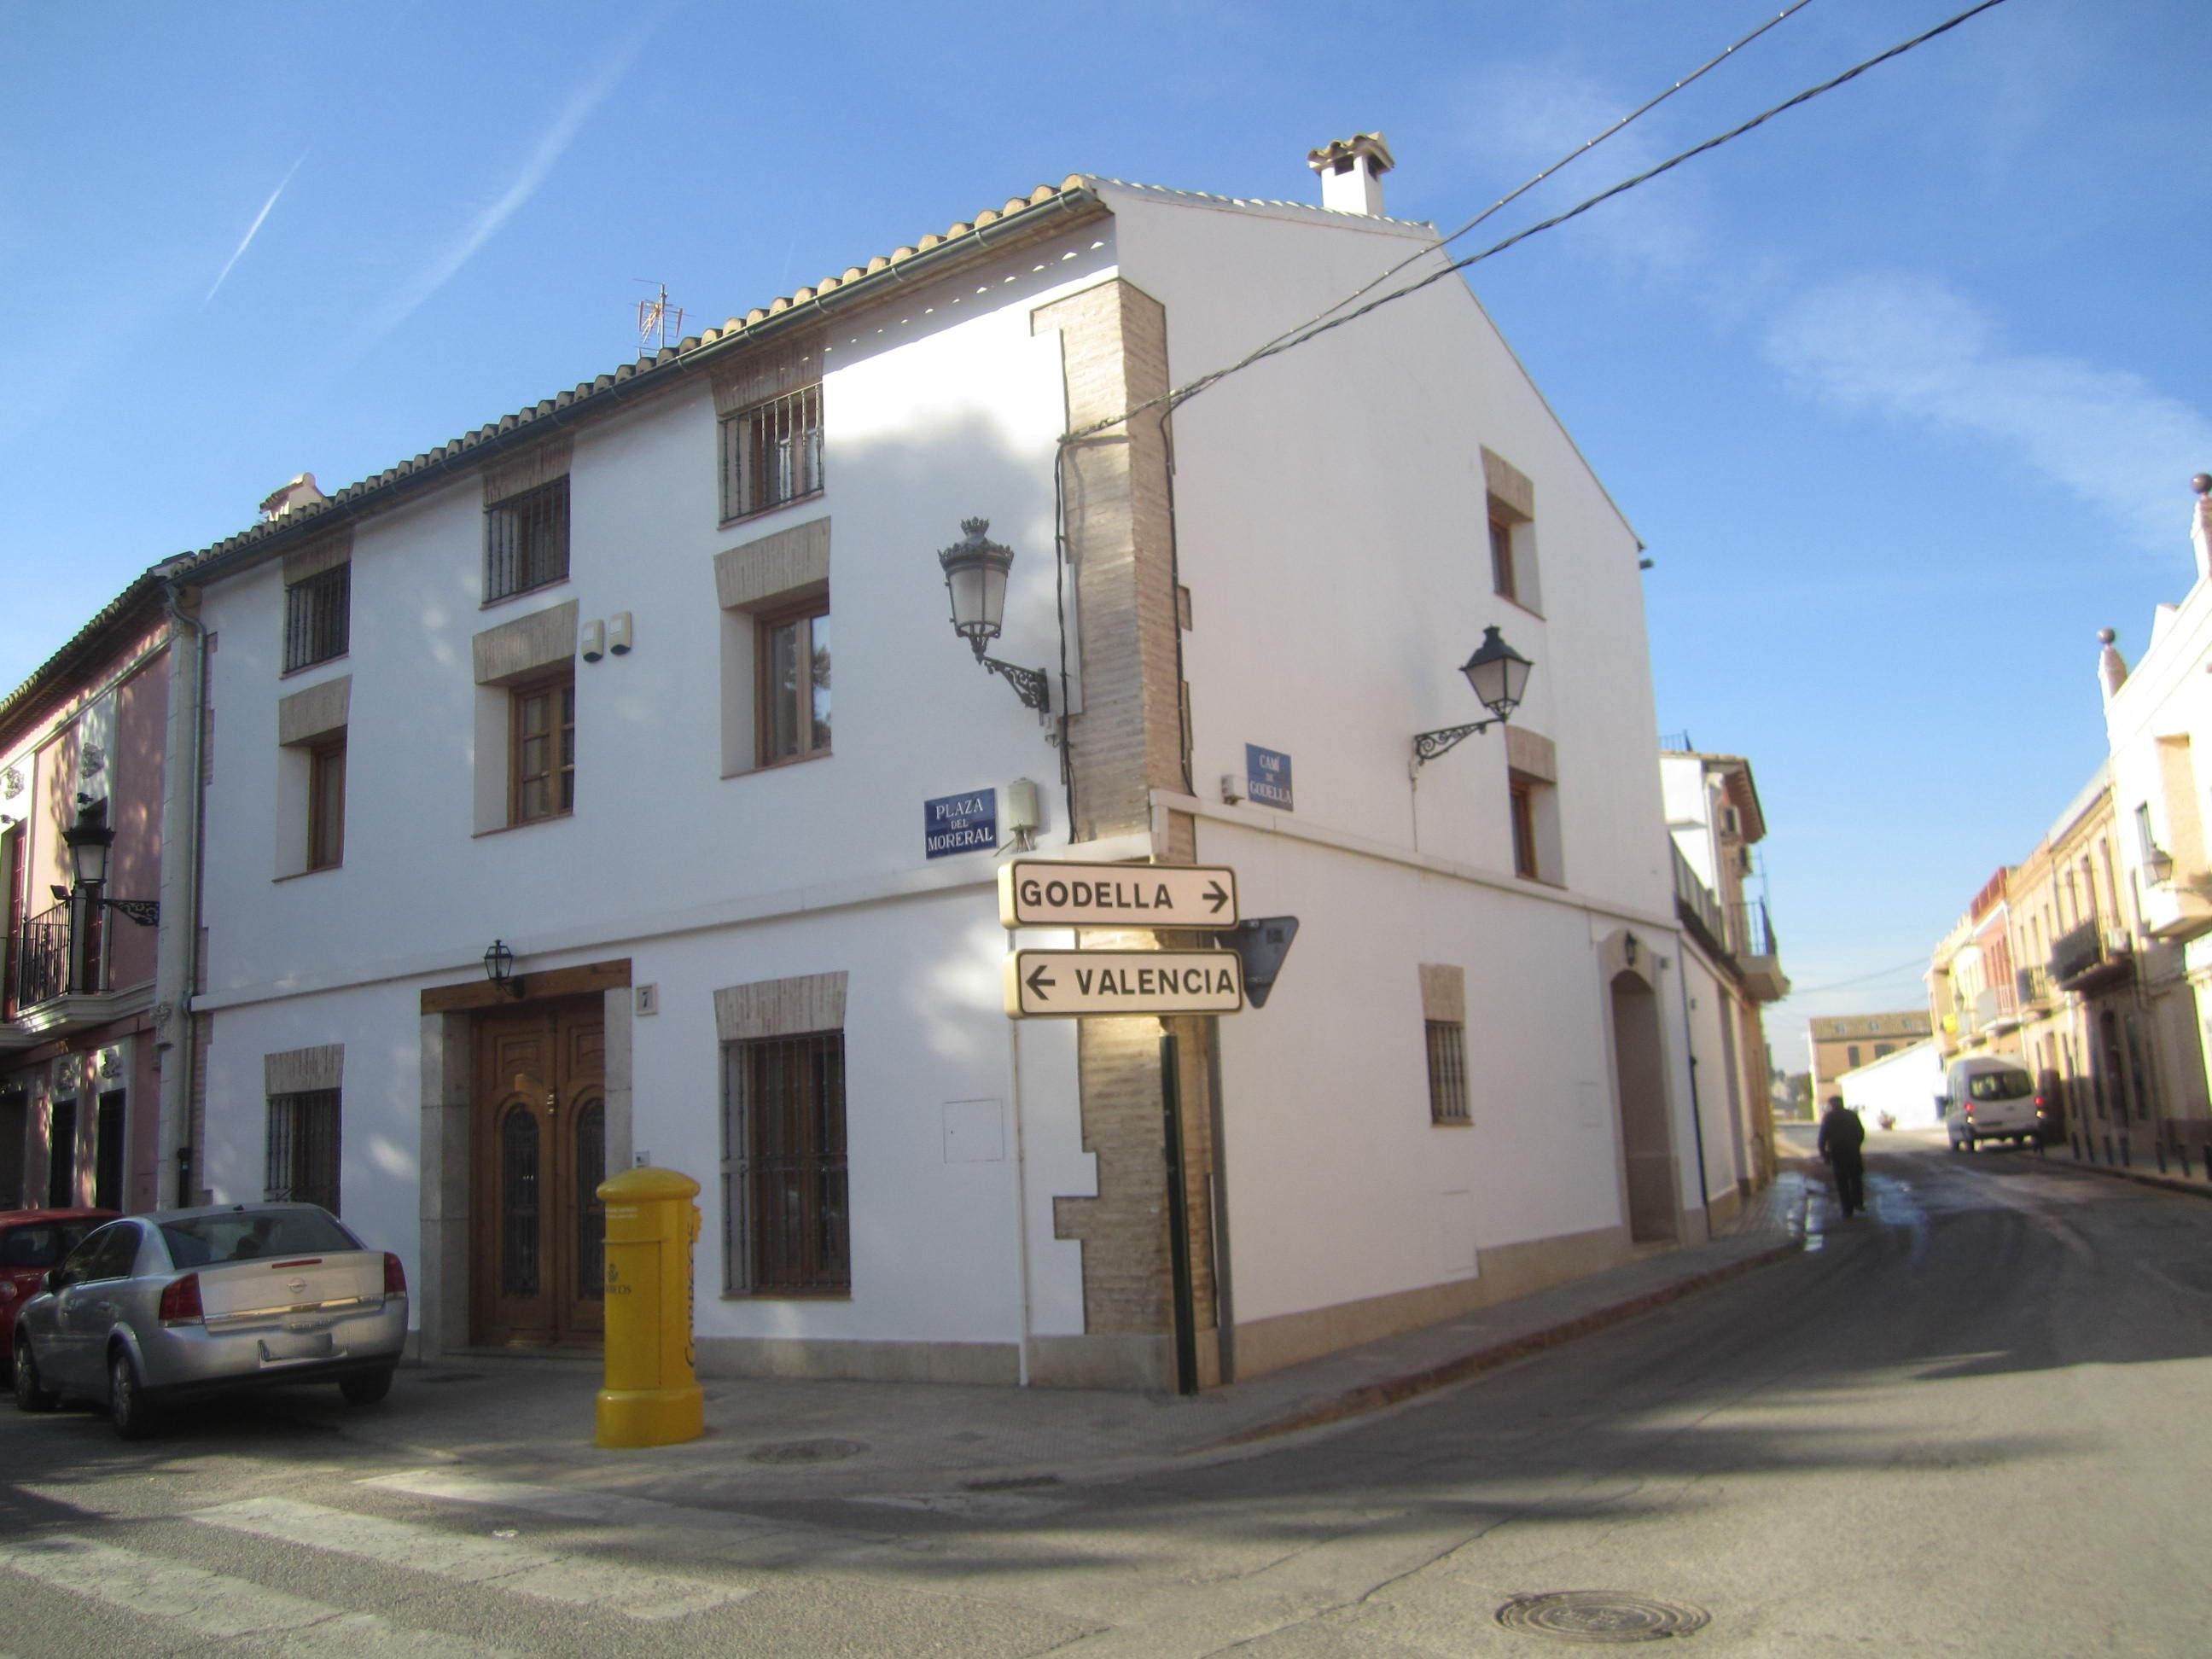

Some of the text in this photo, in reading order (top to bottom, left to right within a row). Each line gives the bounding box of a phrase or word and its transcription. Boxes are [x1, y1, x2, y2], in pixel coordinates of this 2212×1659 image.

[1250, 780, 1293, 804] GODELLA
[936, 798, 983, 820] PLAZA
[951, 818, 969, 830] DEL
[928, 827, 993, 852] MORERAL
[1020, 880, 1173, 909] GODELLA
[1075, 969, 1235, 996] VALENCIA
[642, 990, 649, 1008] 7
